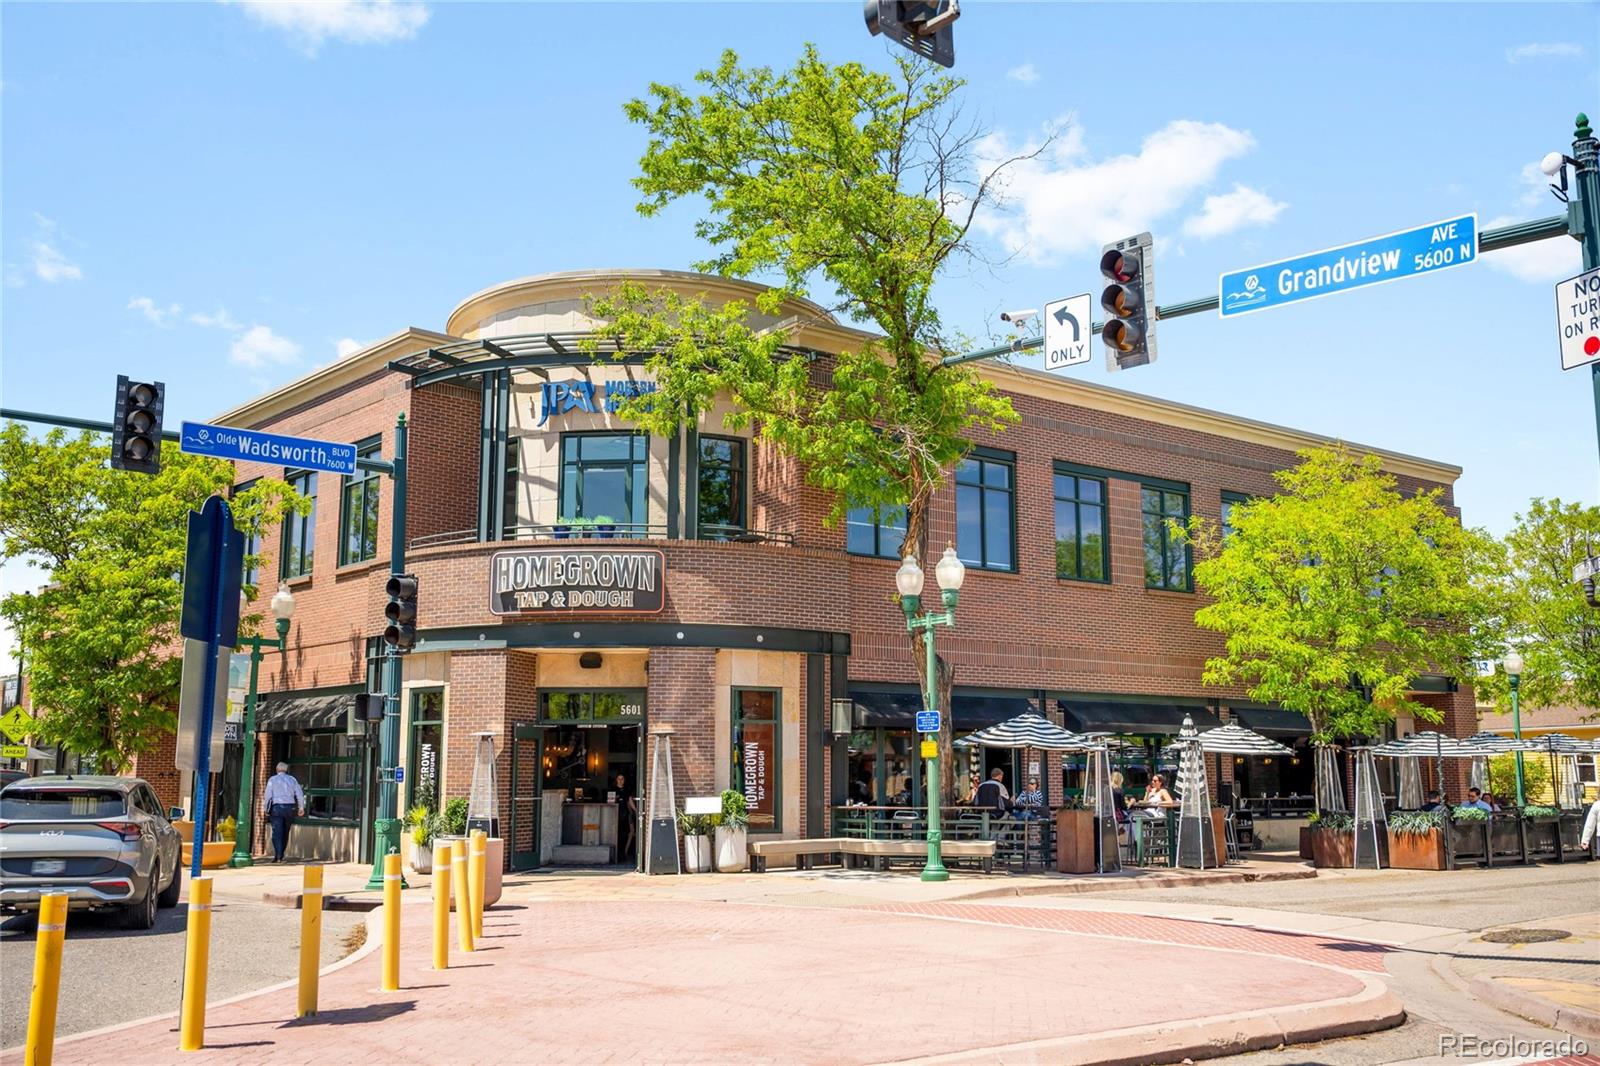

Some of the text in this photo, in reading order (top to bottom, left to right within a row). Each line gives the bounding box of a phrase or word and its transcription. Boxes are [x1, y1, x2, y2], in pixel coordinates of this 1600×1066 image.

[1430, 223, 1458, 244] AVE
[1414, 243, 1471, 271] 5600 N
[1278, 248, 1401, 296] Grandview
[1574, 275, 1600, 299] NO
[1571, 296, 1600, 318] TUR
[1564, 320, 1584, 339] ON
[1051, 344, 1084, 364] ONLY
[216, 432, 327, 464] Olde Wadsworth
[331, 447, 350, 458] BLVD
[327, 459, 354, 471] 7600 W
[496, 554, 655, 594] HOMEGROWN
[514, 590, 634, 608] TAP & DOUGH
[620, 704, 641, 715] 5601
[745, 742, 759, 810] HOMEGROWN
